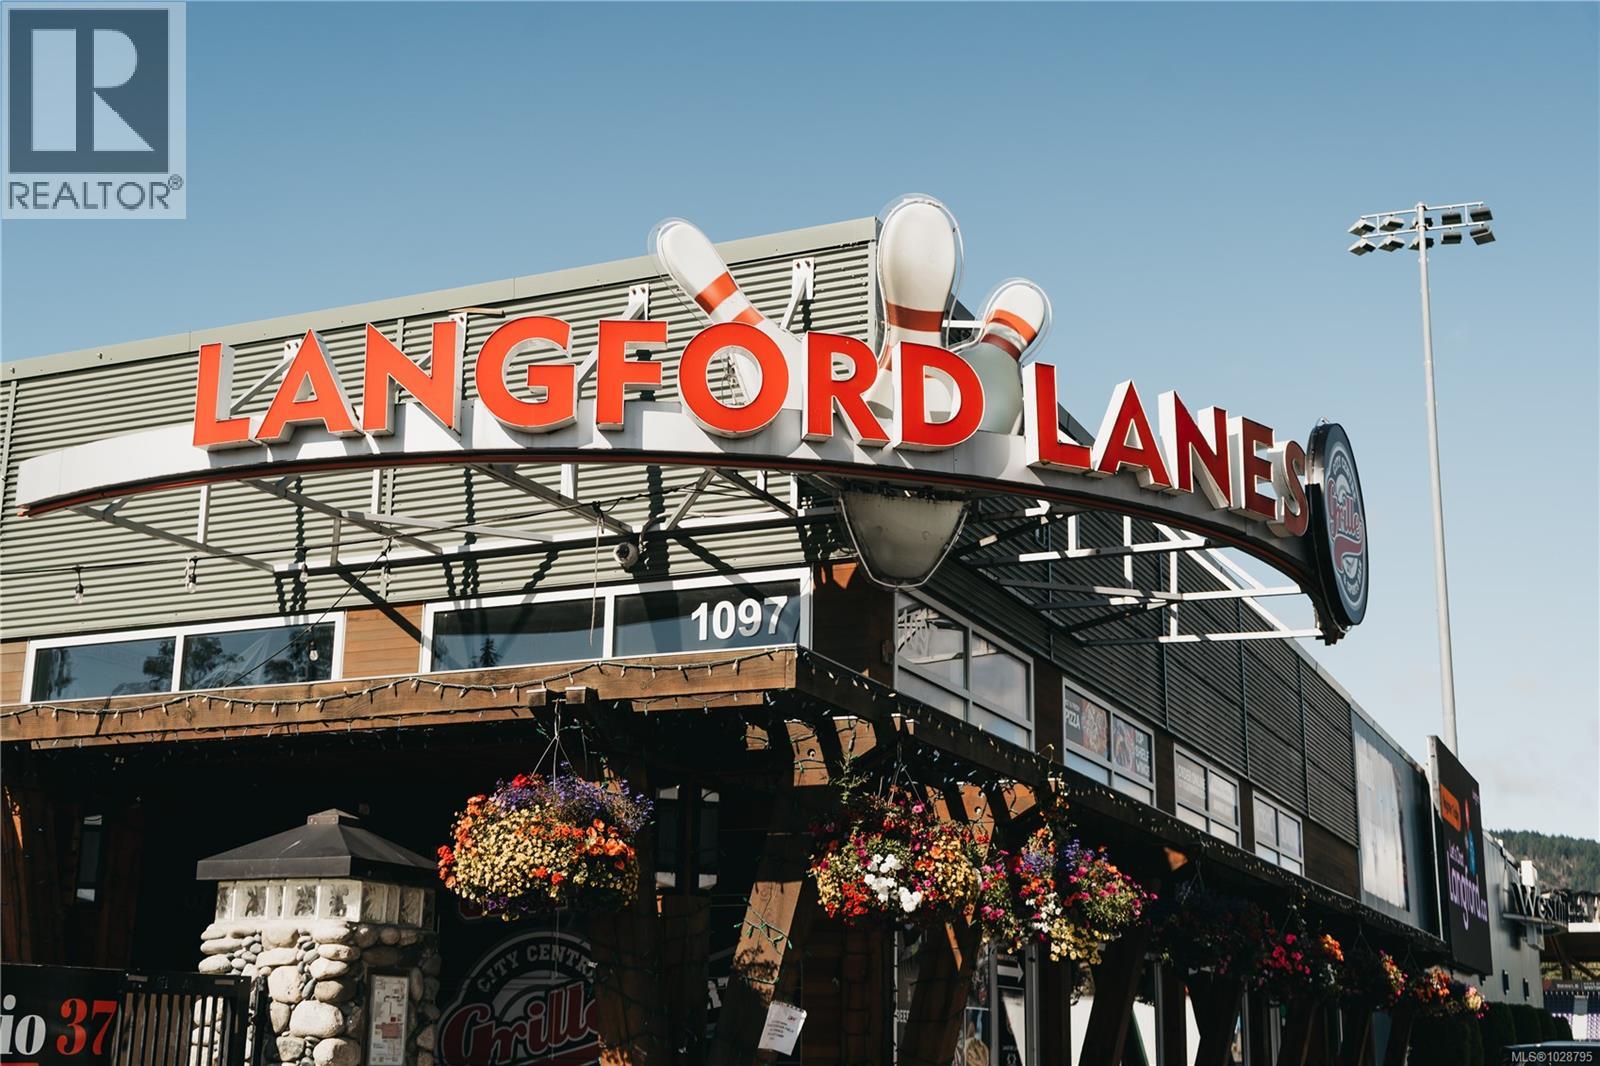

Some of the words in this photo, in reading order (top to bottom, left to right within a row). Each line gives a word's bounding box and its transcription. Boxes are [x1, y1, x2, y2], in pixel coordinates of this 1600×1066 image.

[193, 315, 985, 452] LANGFORD
[1024, 362, 1310, 538] LANES
[1327, 477, 1362, 539] Grille
[690, 596, 788, 641] 1097
[477, 949, 520, 993] CITY
[56, 997, 118, 1056] 37
